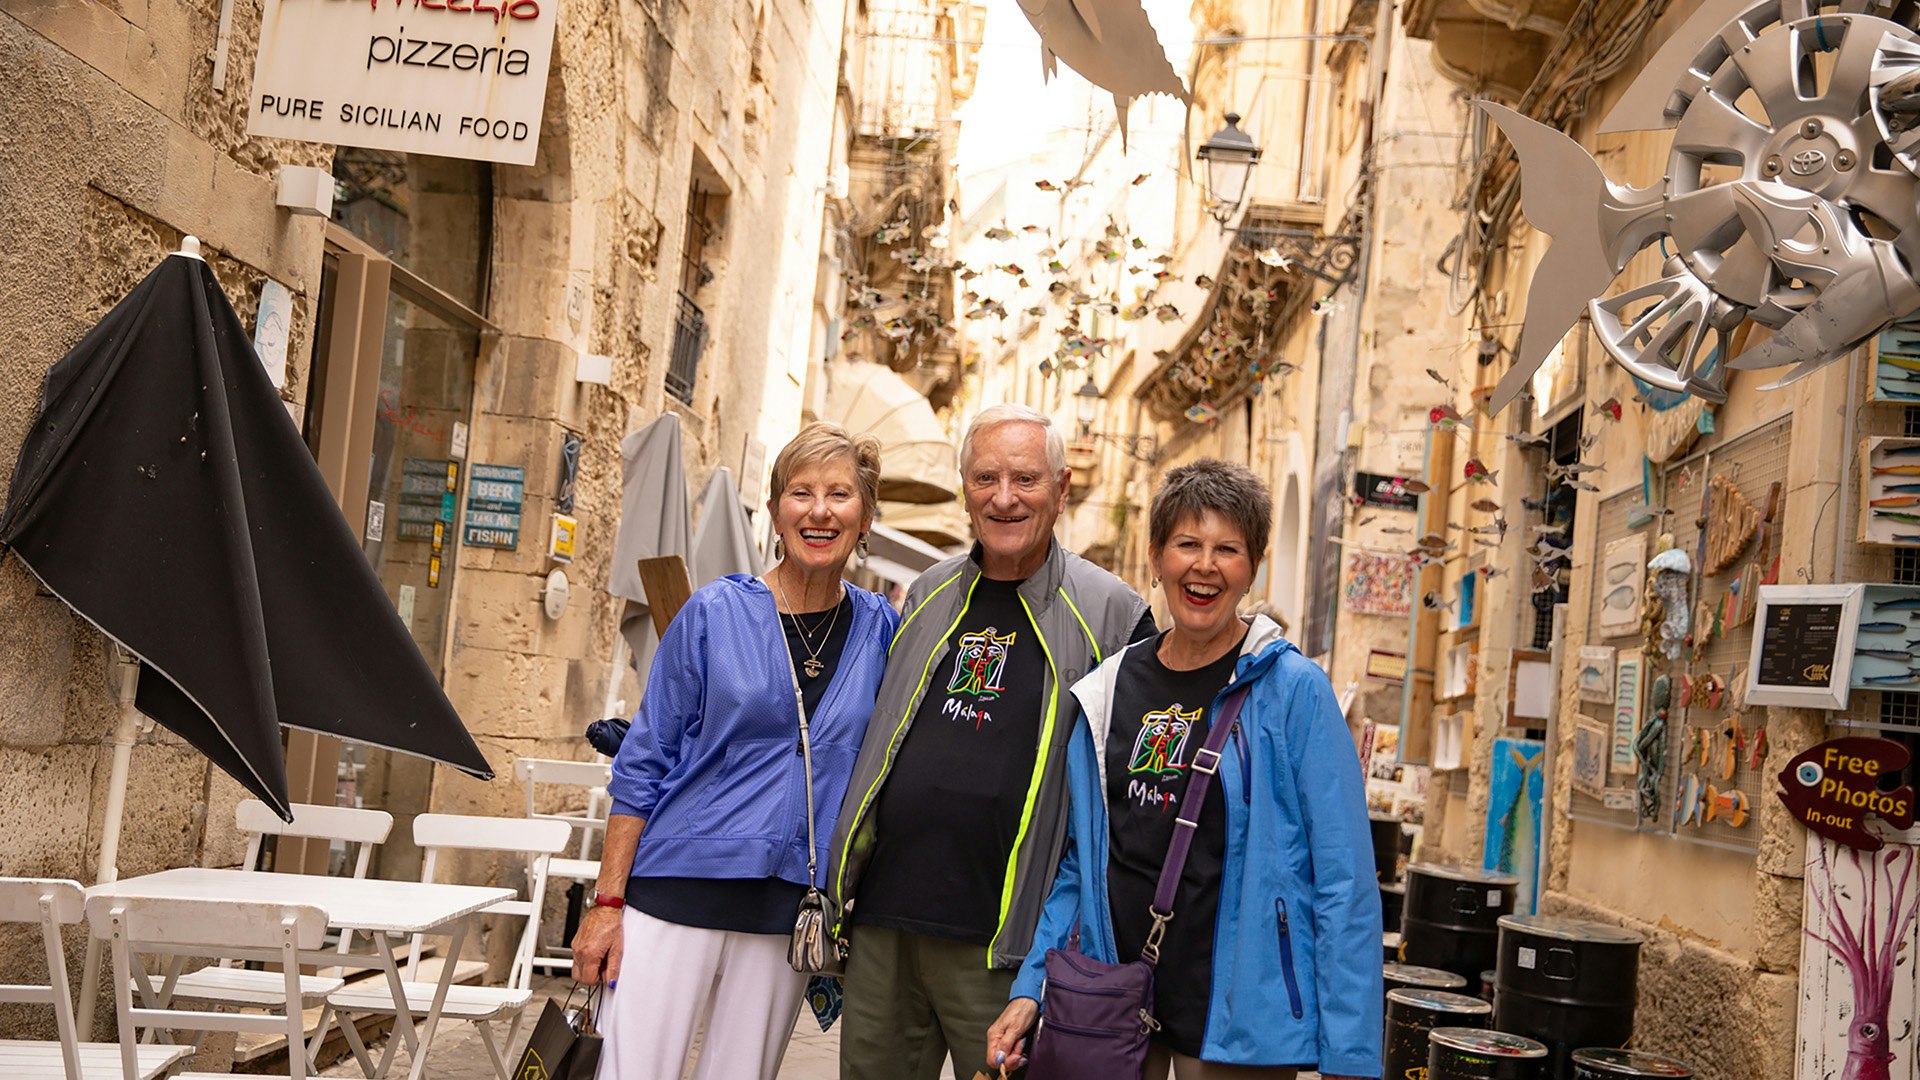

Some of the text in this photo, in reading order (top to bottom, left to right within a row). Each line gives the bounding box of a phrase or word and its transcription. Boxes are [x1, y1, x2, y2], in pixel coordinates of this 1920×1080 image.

[367, 26, 530, 75] pizzeria
[260, 94, 529, 141] PURE SICILIAN FOOD
[477, 481, 514, 500] BEER
[468, 528, 513, 545] FISHIN
[942, 697, 992, 731] Málaga
[1823, 747, 1879, 777] Free
[1128, 779, 1177, 814] Málaga
[1819, 776, 1907, 818] Photos
[1805, 807, 1854, 830] In-out
